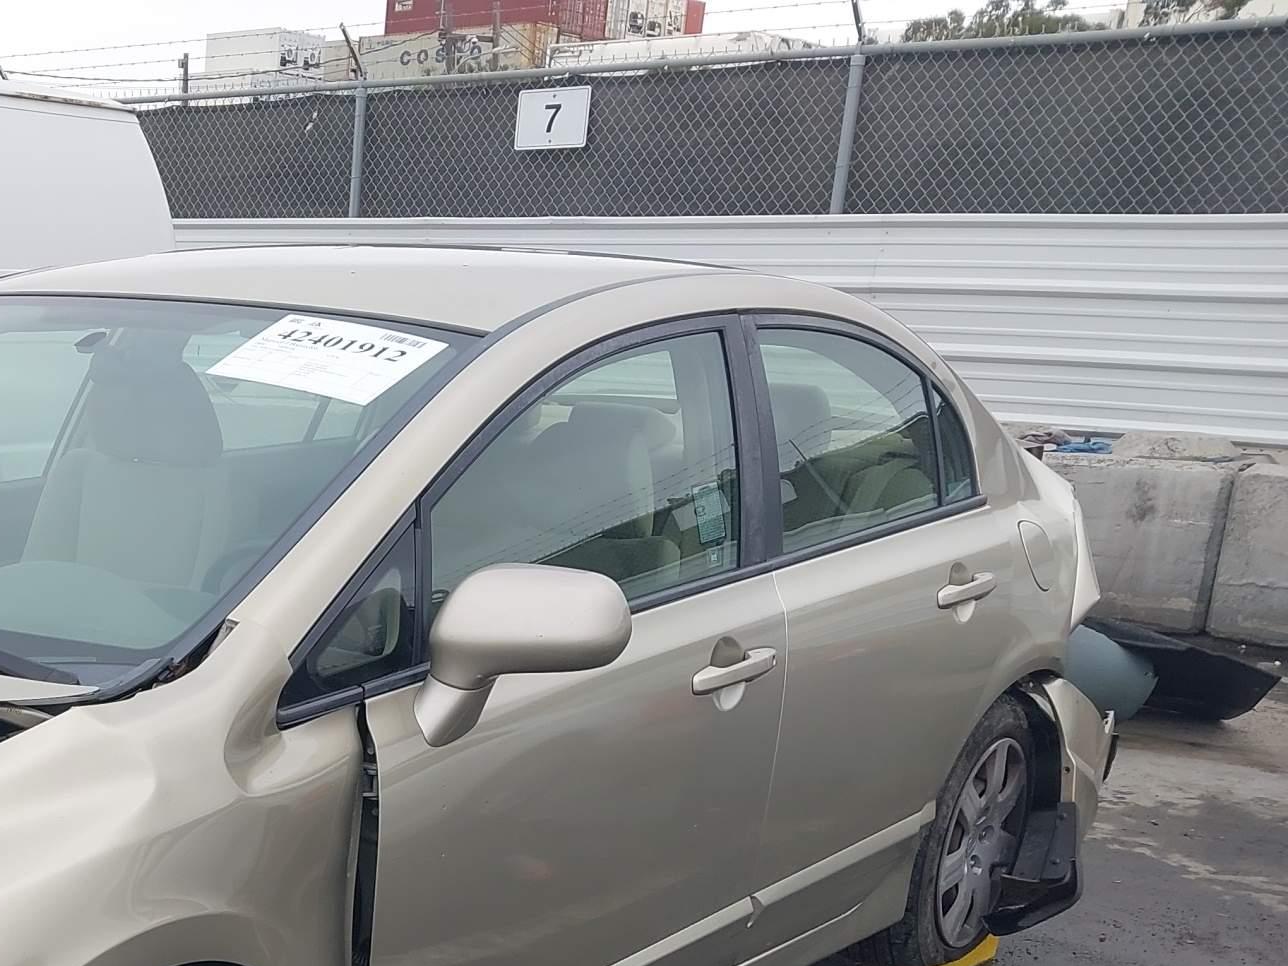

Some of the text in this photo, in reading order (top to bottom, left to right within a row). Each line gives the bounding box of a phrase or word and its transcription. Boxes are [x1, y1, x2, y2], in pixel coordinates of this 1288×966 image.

[400, 44, 481, 66] COSO
[545, 103, 562, 133] 7
[277, 328, 408, 362] 42401912
